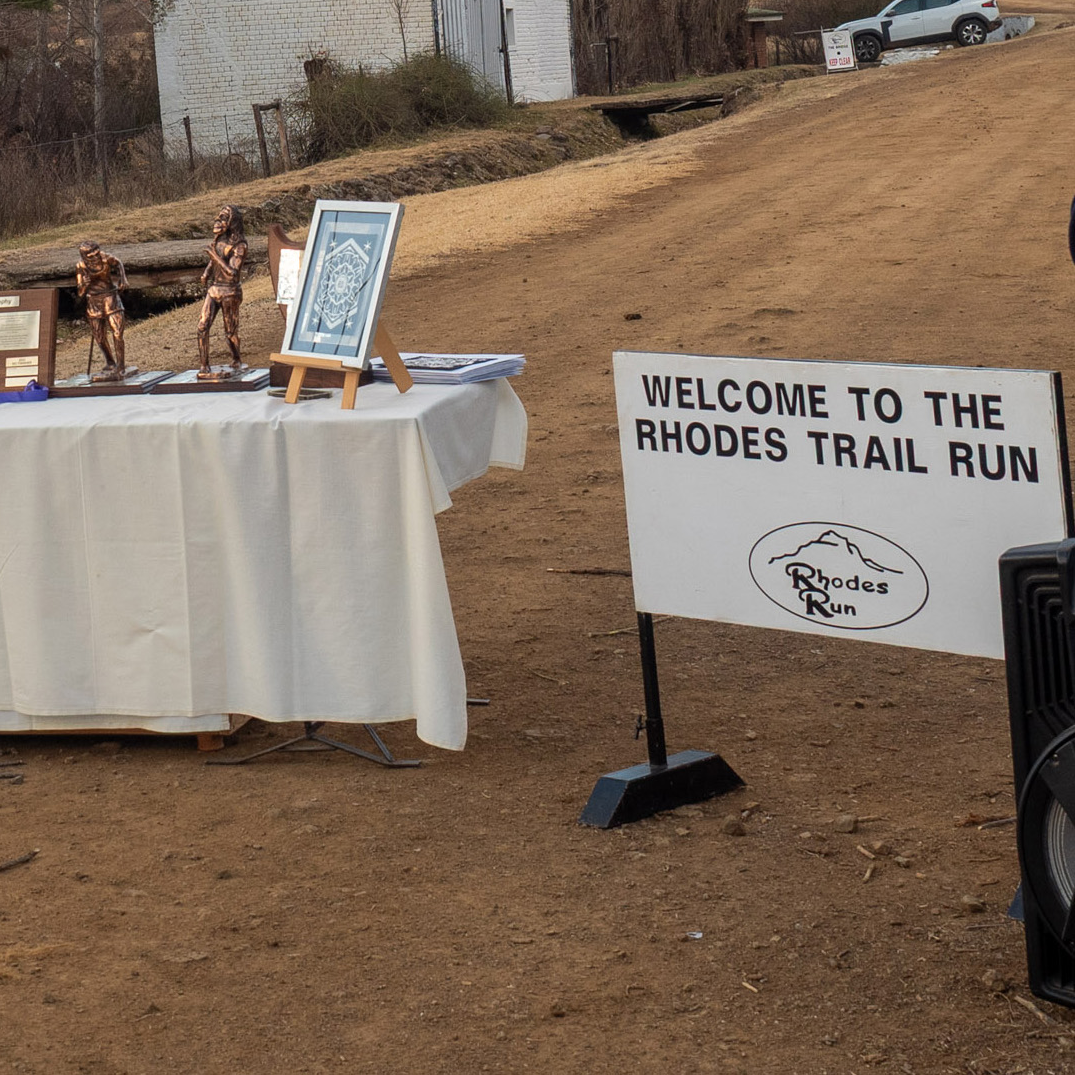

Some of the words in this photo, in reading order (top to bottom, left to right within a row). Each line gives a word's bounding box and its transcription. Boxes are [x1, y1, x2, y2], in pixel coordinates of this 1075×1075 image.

[839, 57, 851, 65] CLEAR
[642, 374, 829, 419] WELCOME
[848, 386, 902, 424] TO
[924, 391, 1005, 431] THE
[635, 418, 788, 462] RHODES
[807, 431, 928, 474] TRAIL
[948, 441, 1039, 483] RUN
[785, 561, 889, 595] Rhodes
[798, 588, 857, 618] Run
